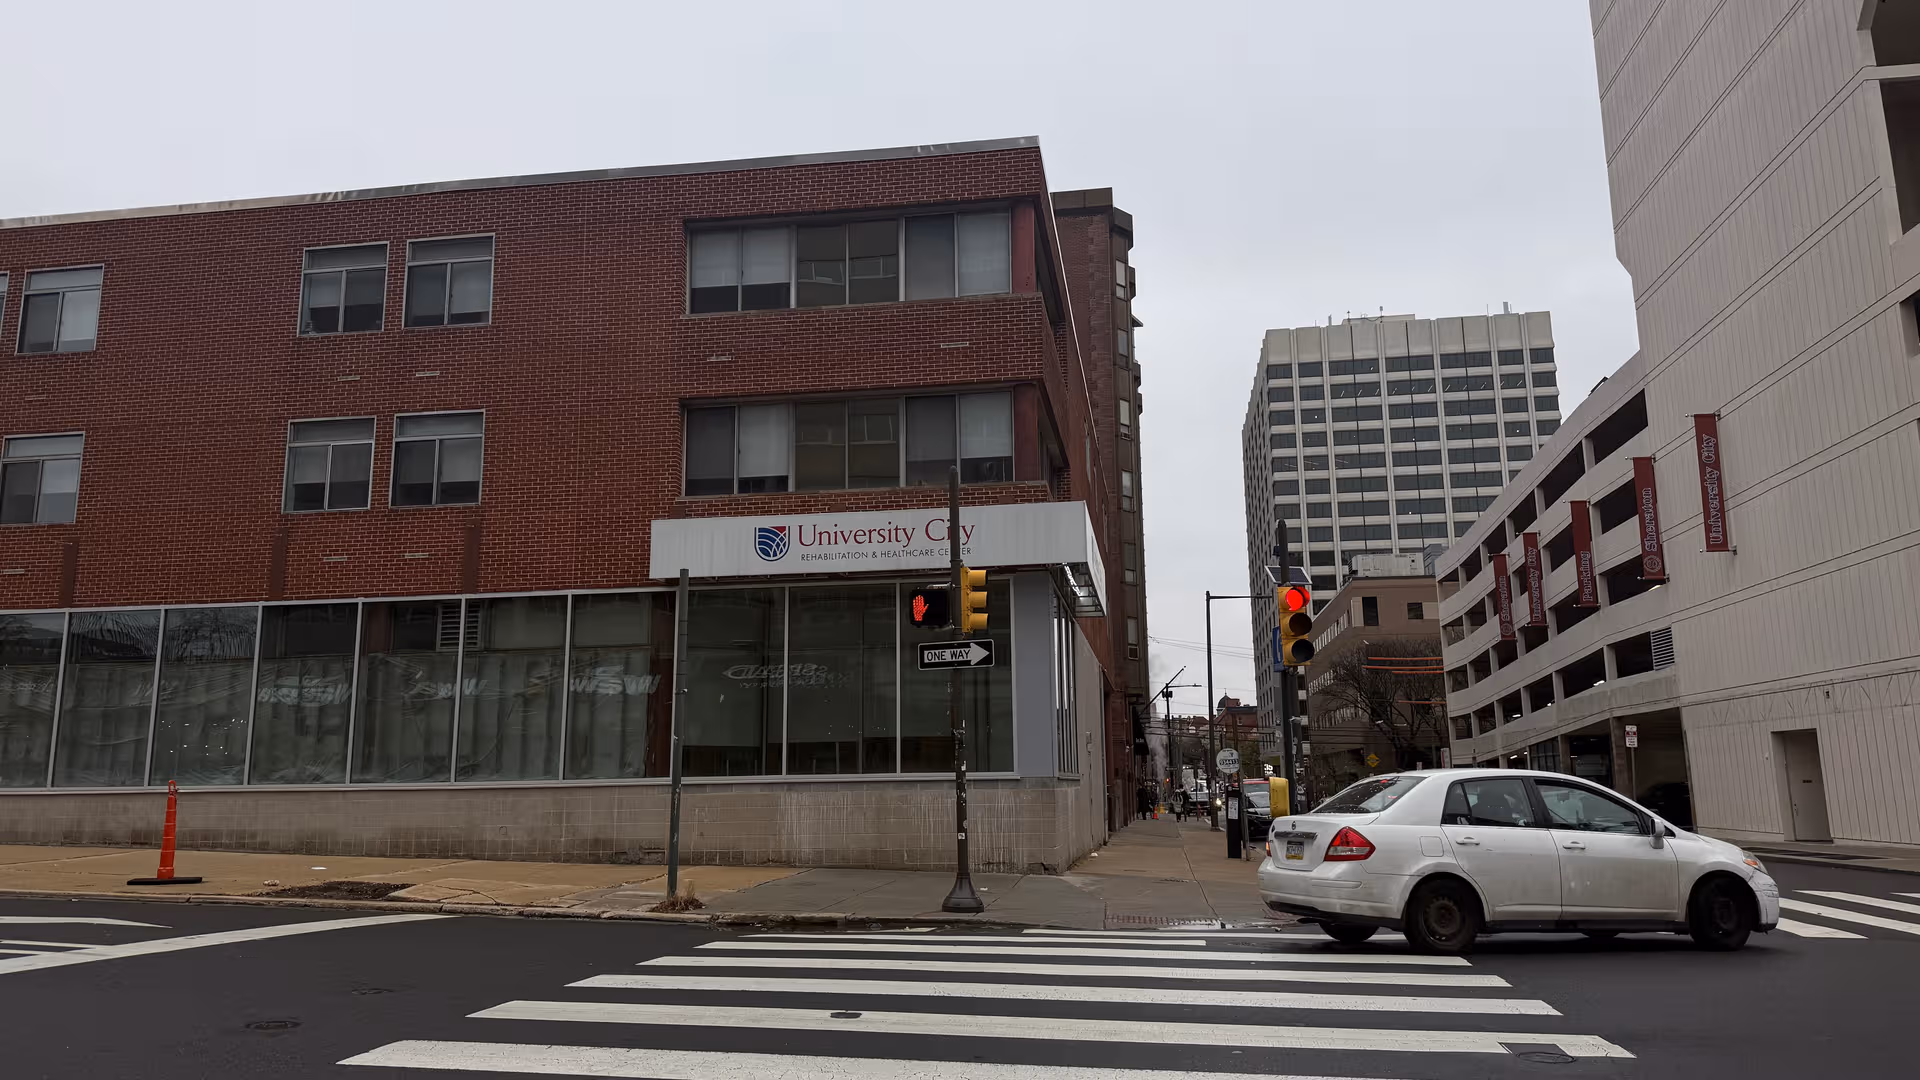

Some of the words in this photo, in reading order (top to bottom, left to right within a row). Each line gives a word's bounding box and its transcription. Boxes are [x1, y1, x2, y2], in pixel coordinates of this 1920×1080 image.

[1701, 433, 1717, 464] City
[1642, 487, 1658, 552] Sheraton
[1704, 466, 1723, 545] University
[798, 521, 916, 548] University
[925, 518, 976, 546] Ciy
[801, 551, 868, 561] REHABILITATION
[871, 550, 878, 559] &
[880, 548, 935, 558] HEALTHCARE
[937, 547, 972, 557] CEER
[1579, 550, 1593, 602] Parking
[926, 650, 947, 662] ONE
[950, 648, 971, 660] WAY
